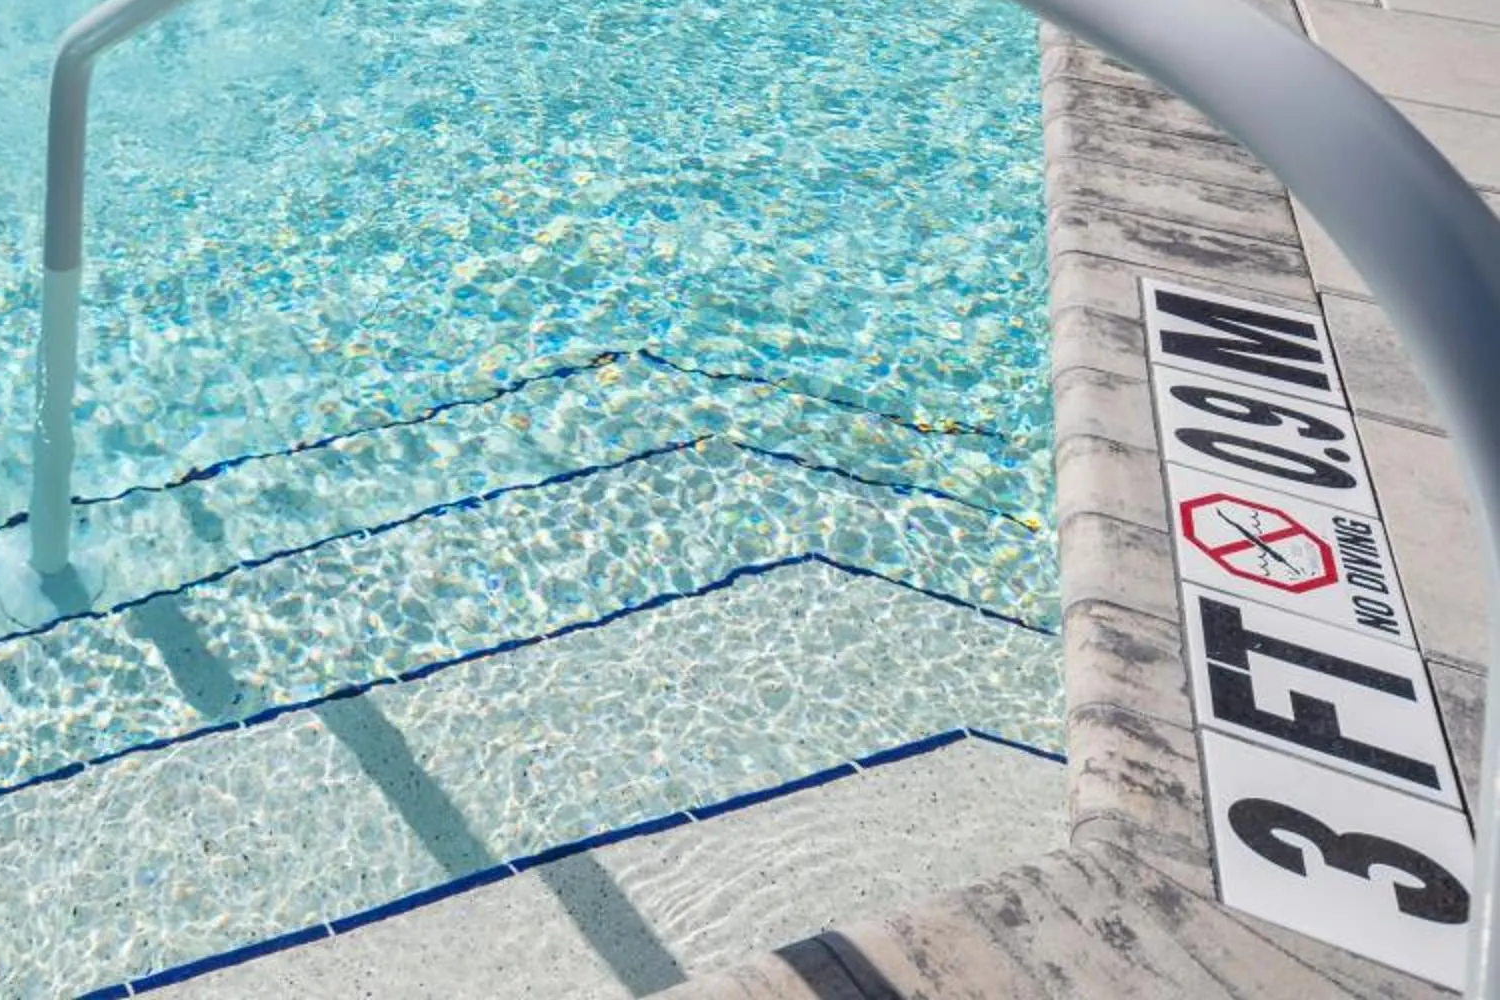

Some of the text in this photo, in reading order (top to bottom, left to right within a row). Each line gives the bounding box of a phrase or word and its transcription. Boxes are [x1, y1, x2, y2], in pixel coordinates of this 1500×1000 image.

[1154, 289, 1357, 489] 0.9 M
[1331, 515, 1401, 636] NO DIVING
[1198, 595, 1471, 925] 3 FT
